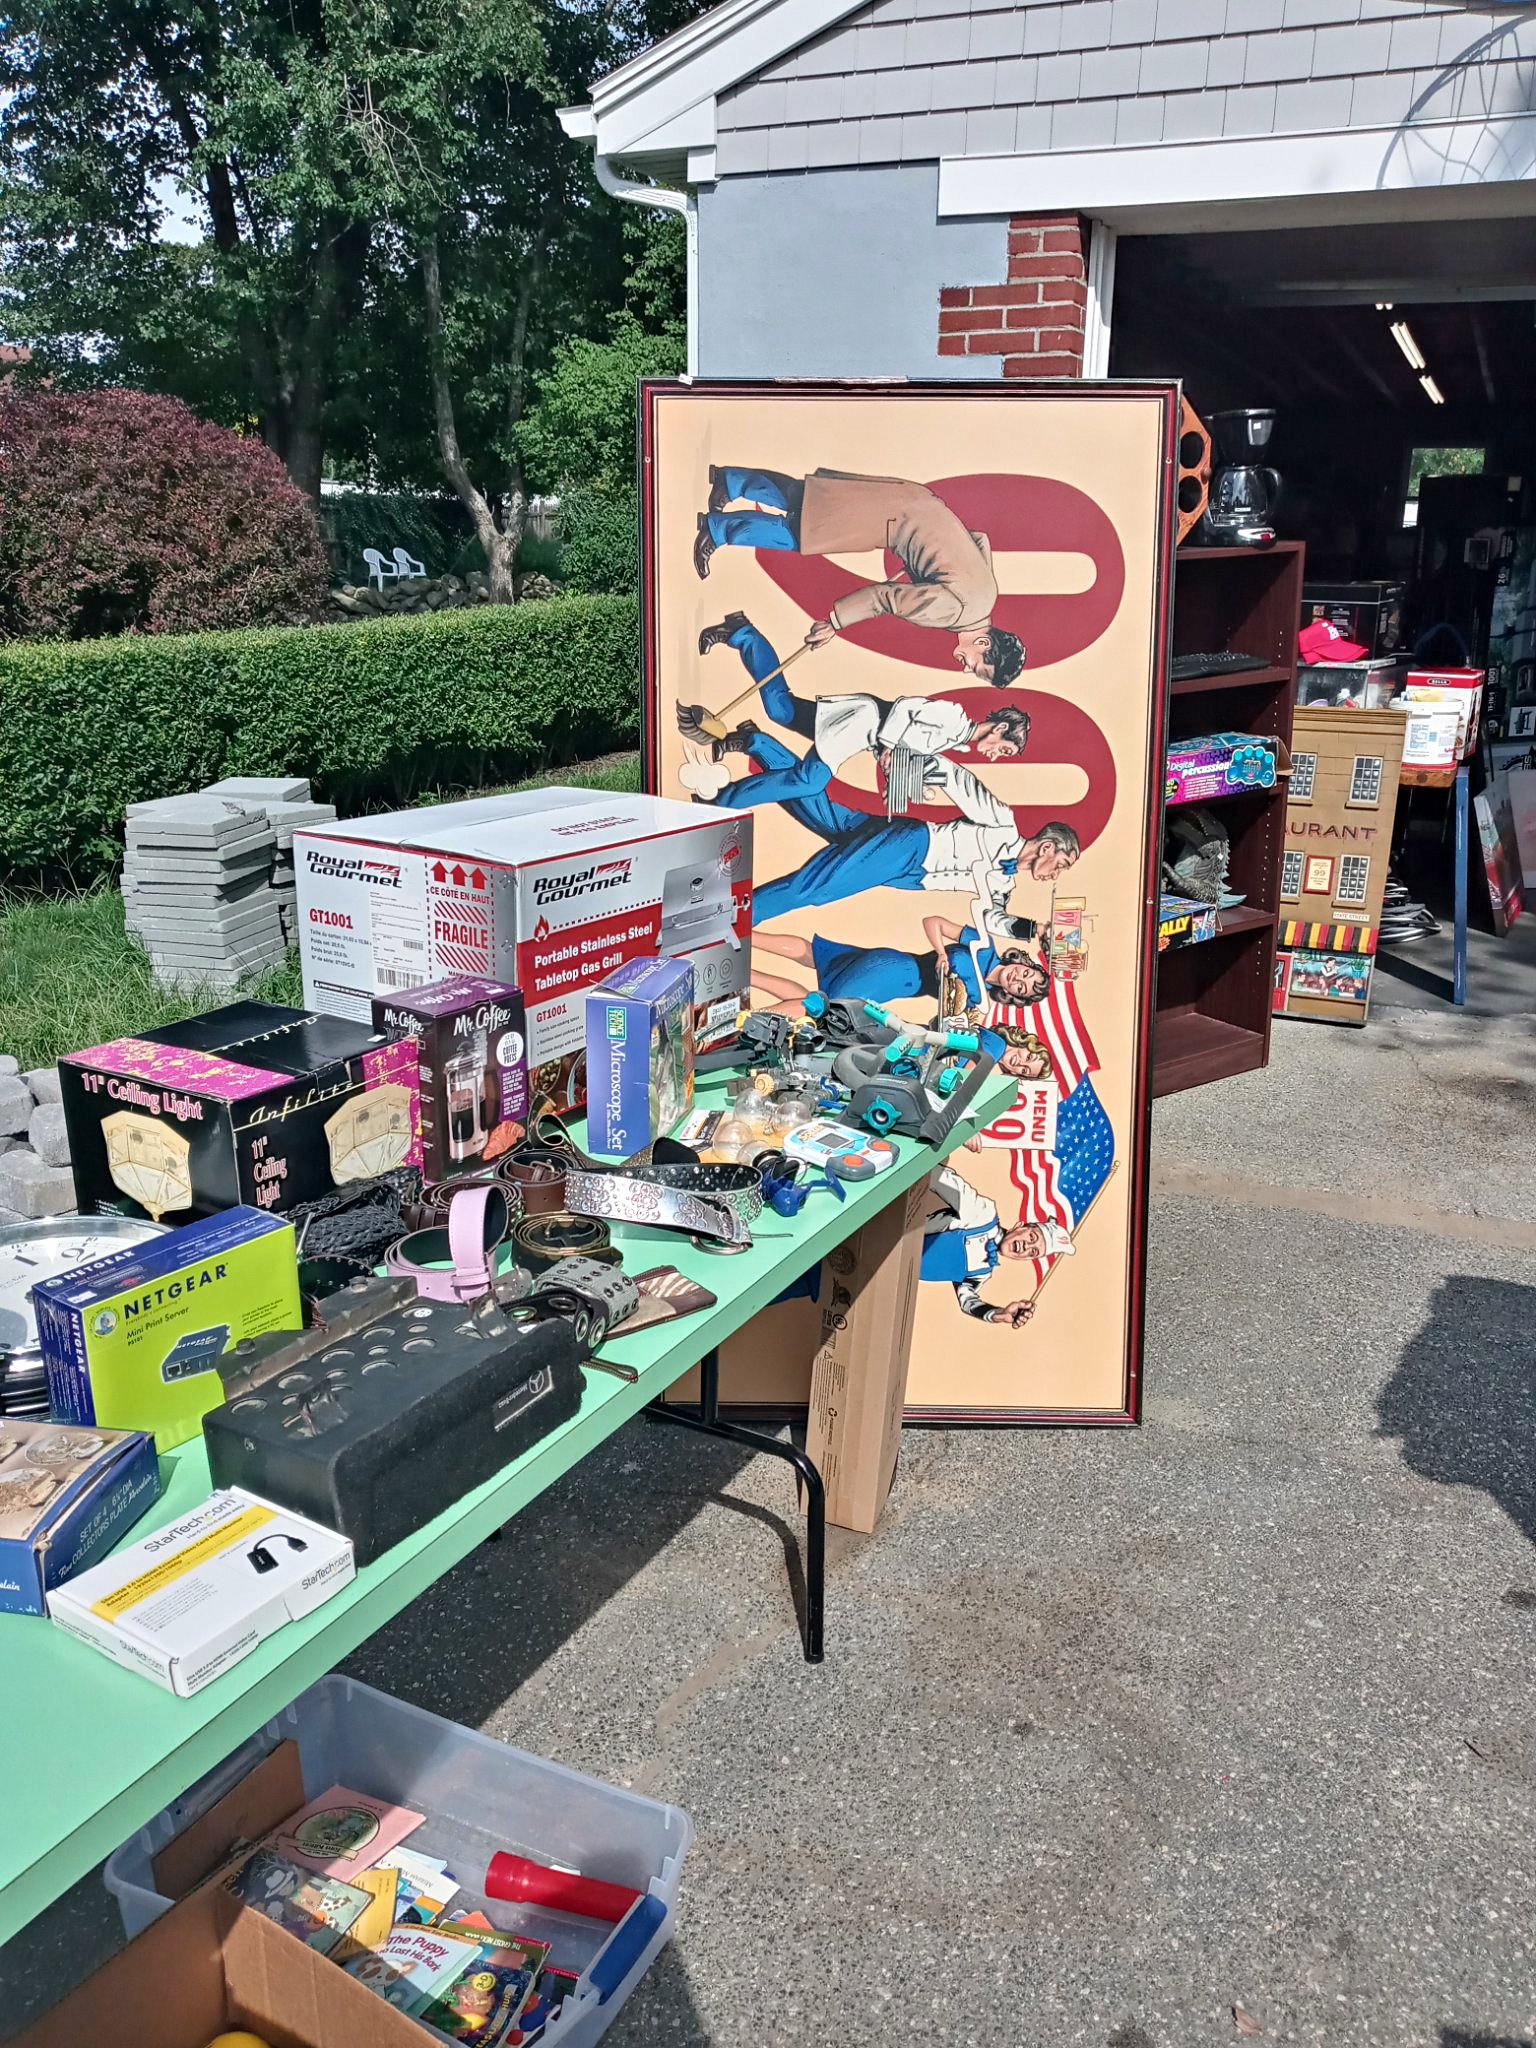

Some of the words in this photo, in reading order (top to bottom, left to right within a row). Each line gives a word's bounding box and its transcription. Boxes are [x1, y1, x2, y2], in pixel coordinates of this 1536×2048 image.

[1169, 758, 1196, 772] Digital
[1181, 761, 1231, 779] percussion
[1286, 821, 1377, 840] URANT
[306, 850, 364, 871] Royal
[310, 862, 403, 889] Gourmet
[533, 866, 596, 893] Royal
[536, 871, 632, 906] Gourmet
[430, 886, 440, 896] CE
[440, 886, 459, 900] CÔTÉ
[459, 890, 470, 902] EN
[471, 894, 490, 905] HAUT
[309, 908, 354, 930] GT1001
[1159, 915, 1191, 938] ALLY
[434, 920, 489, 951] FRAGILE
[534, 945, 579, 968] Portable
[581, 932, 627, 953] Stainless
[628, 921, 653, 939] Steel
[534, 968, 579, 991] Tabletop
[581, 960, 600, 976] Gas
[602, 952, 623, 969] Grill
[383, 1008, 400, 1028] Mr.
[398, 1011, 425, 1037] Coffee
[453, 1014, 475, 1037] Mr.
[476, 1004, 511, 1034] Coffee
[536, 1003, 568, 1023] GT1001
[502, 1044, 518, 1057] COFFEE
[503, 1054, 518, 1066] PRESS
[607, 1040, 626, 1121] Microscope
[107, 1078, 160, 1115] Ceiling
[163, 1092, 204, 1122] Light
[1031, 1090, 1048, 1144] MENU
[612, 1128, 627, 1151] Set
[253, 1156, 287, 1183] Ceiling
[255, 1180, 281, 1208] Light
[63, 1250, 136, 1280] NETGEAR
[124, 1263, 228, 1319] NETGEAR
[126, 1324, 144, 1339] Mini
[146, 1316, 164, 1332] Print
[165, 1306, 190, 1327] Server
[71, 1312, 86, 1375] NETGEAR
[58, 1561, 72, 1579] Fine
[72, 1518, 110, 1565] COLLECTORS
[109, 1500, 129, 1527] PLATE
[80, 1521, 92, 1543] SET
[93, 1513, 103, 1529] OF
[144, 1498, 237, 1553] StarTech.com
[301, 1552, 351, 1590] StarTech.com
[388, 1934, 411, 1947] The
[413, 1934, 450, 1956] Puppy
[390, 1946, 409, 1957] Lost
[410, 1950, 423, 1961] His
[422, 1955, 442, 1972] Bark
[477, 1974, 489, 1989] 3-D
